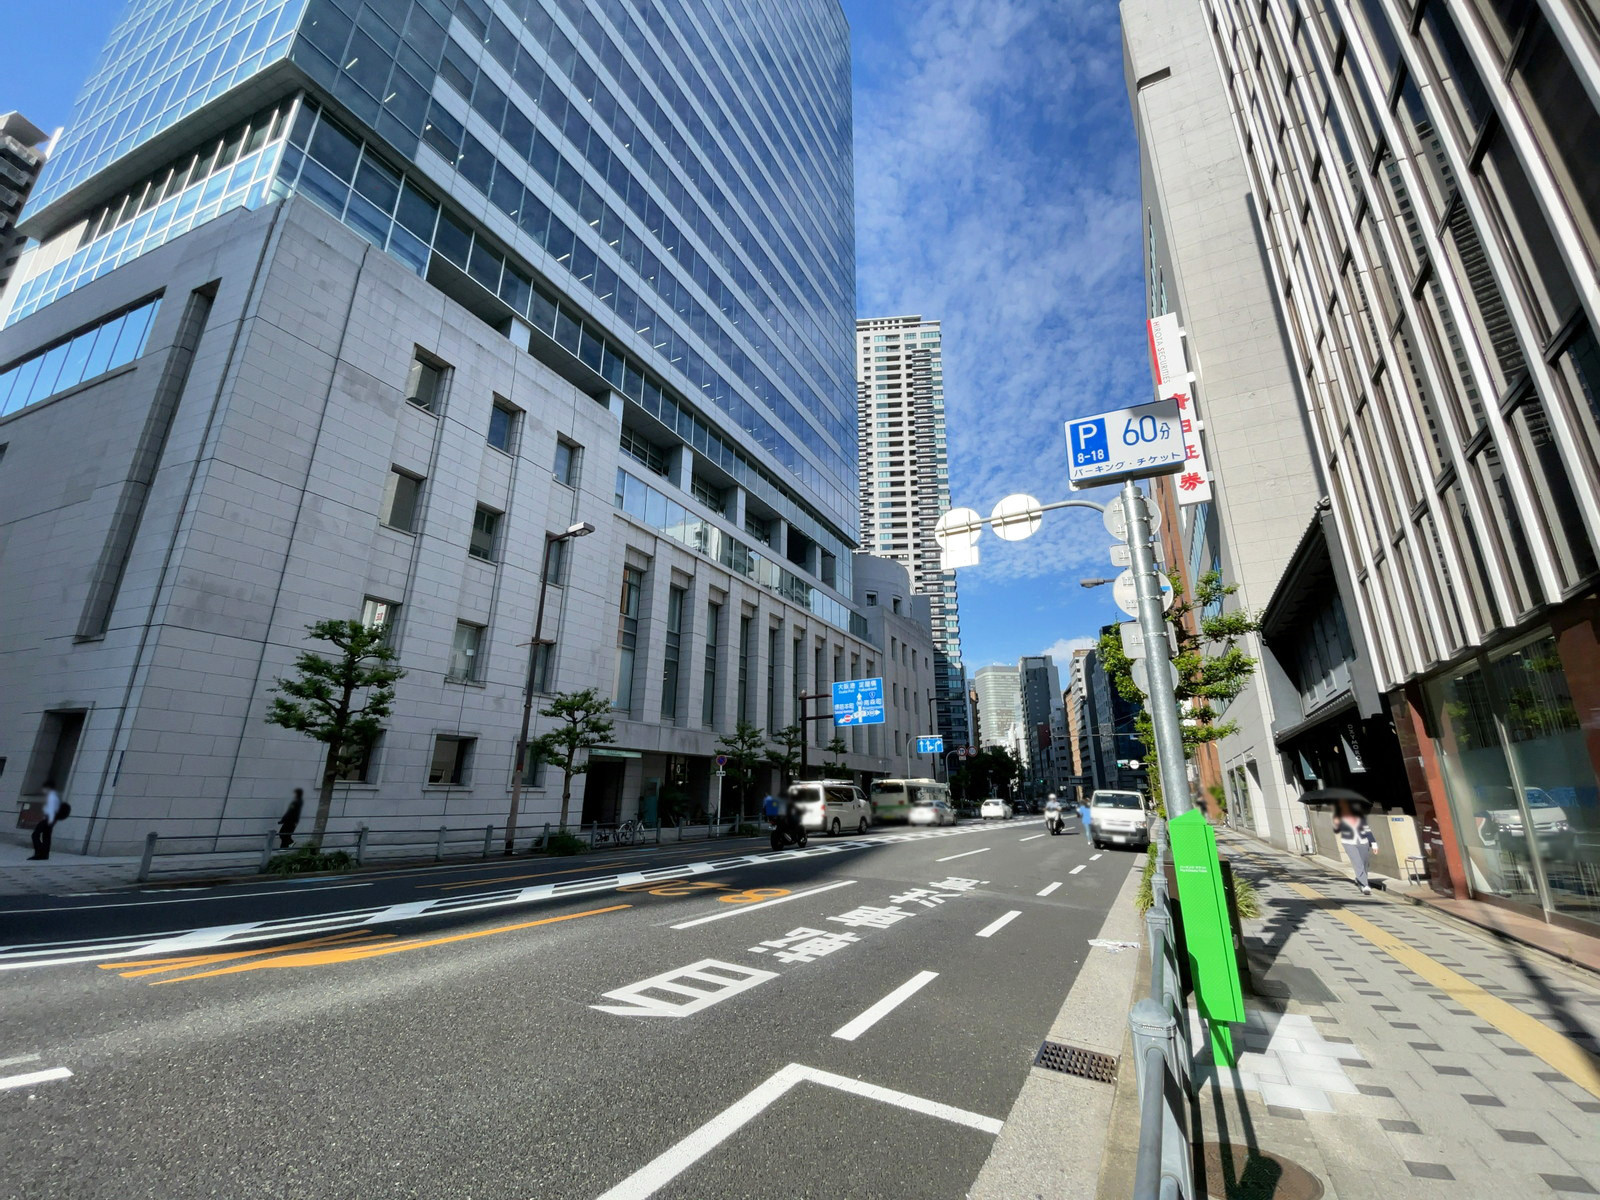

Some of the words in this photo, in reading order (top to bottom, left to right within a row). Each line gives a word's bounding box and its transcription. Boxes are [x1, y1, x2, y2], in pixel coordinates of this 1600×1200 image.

[1153, 321, 1162, 346] HIROTA
[1157, 347, 1171, 384] SECURITIES
[1078, 423, 1098, 450] P
[1122, 415, 1171, 446] 60分
[1077, 449, 1105, 464] 8-18
